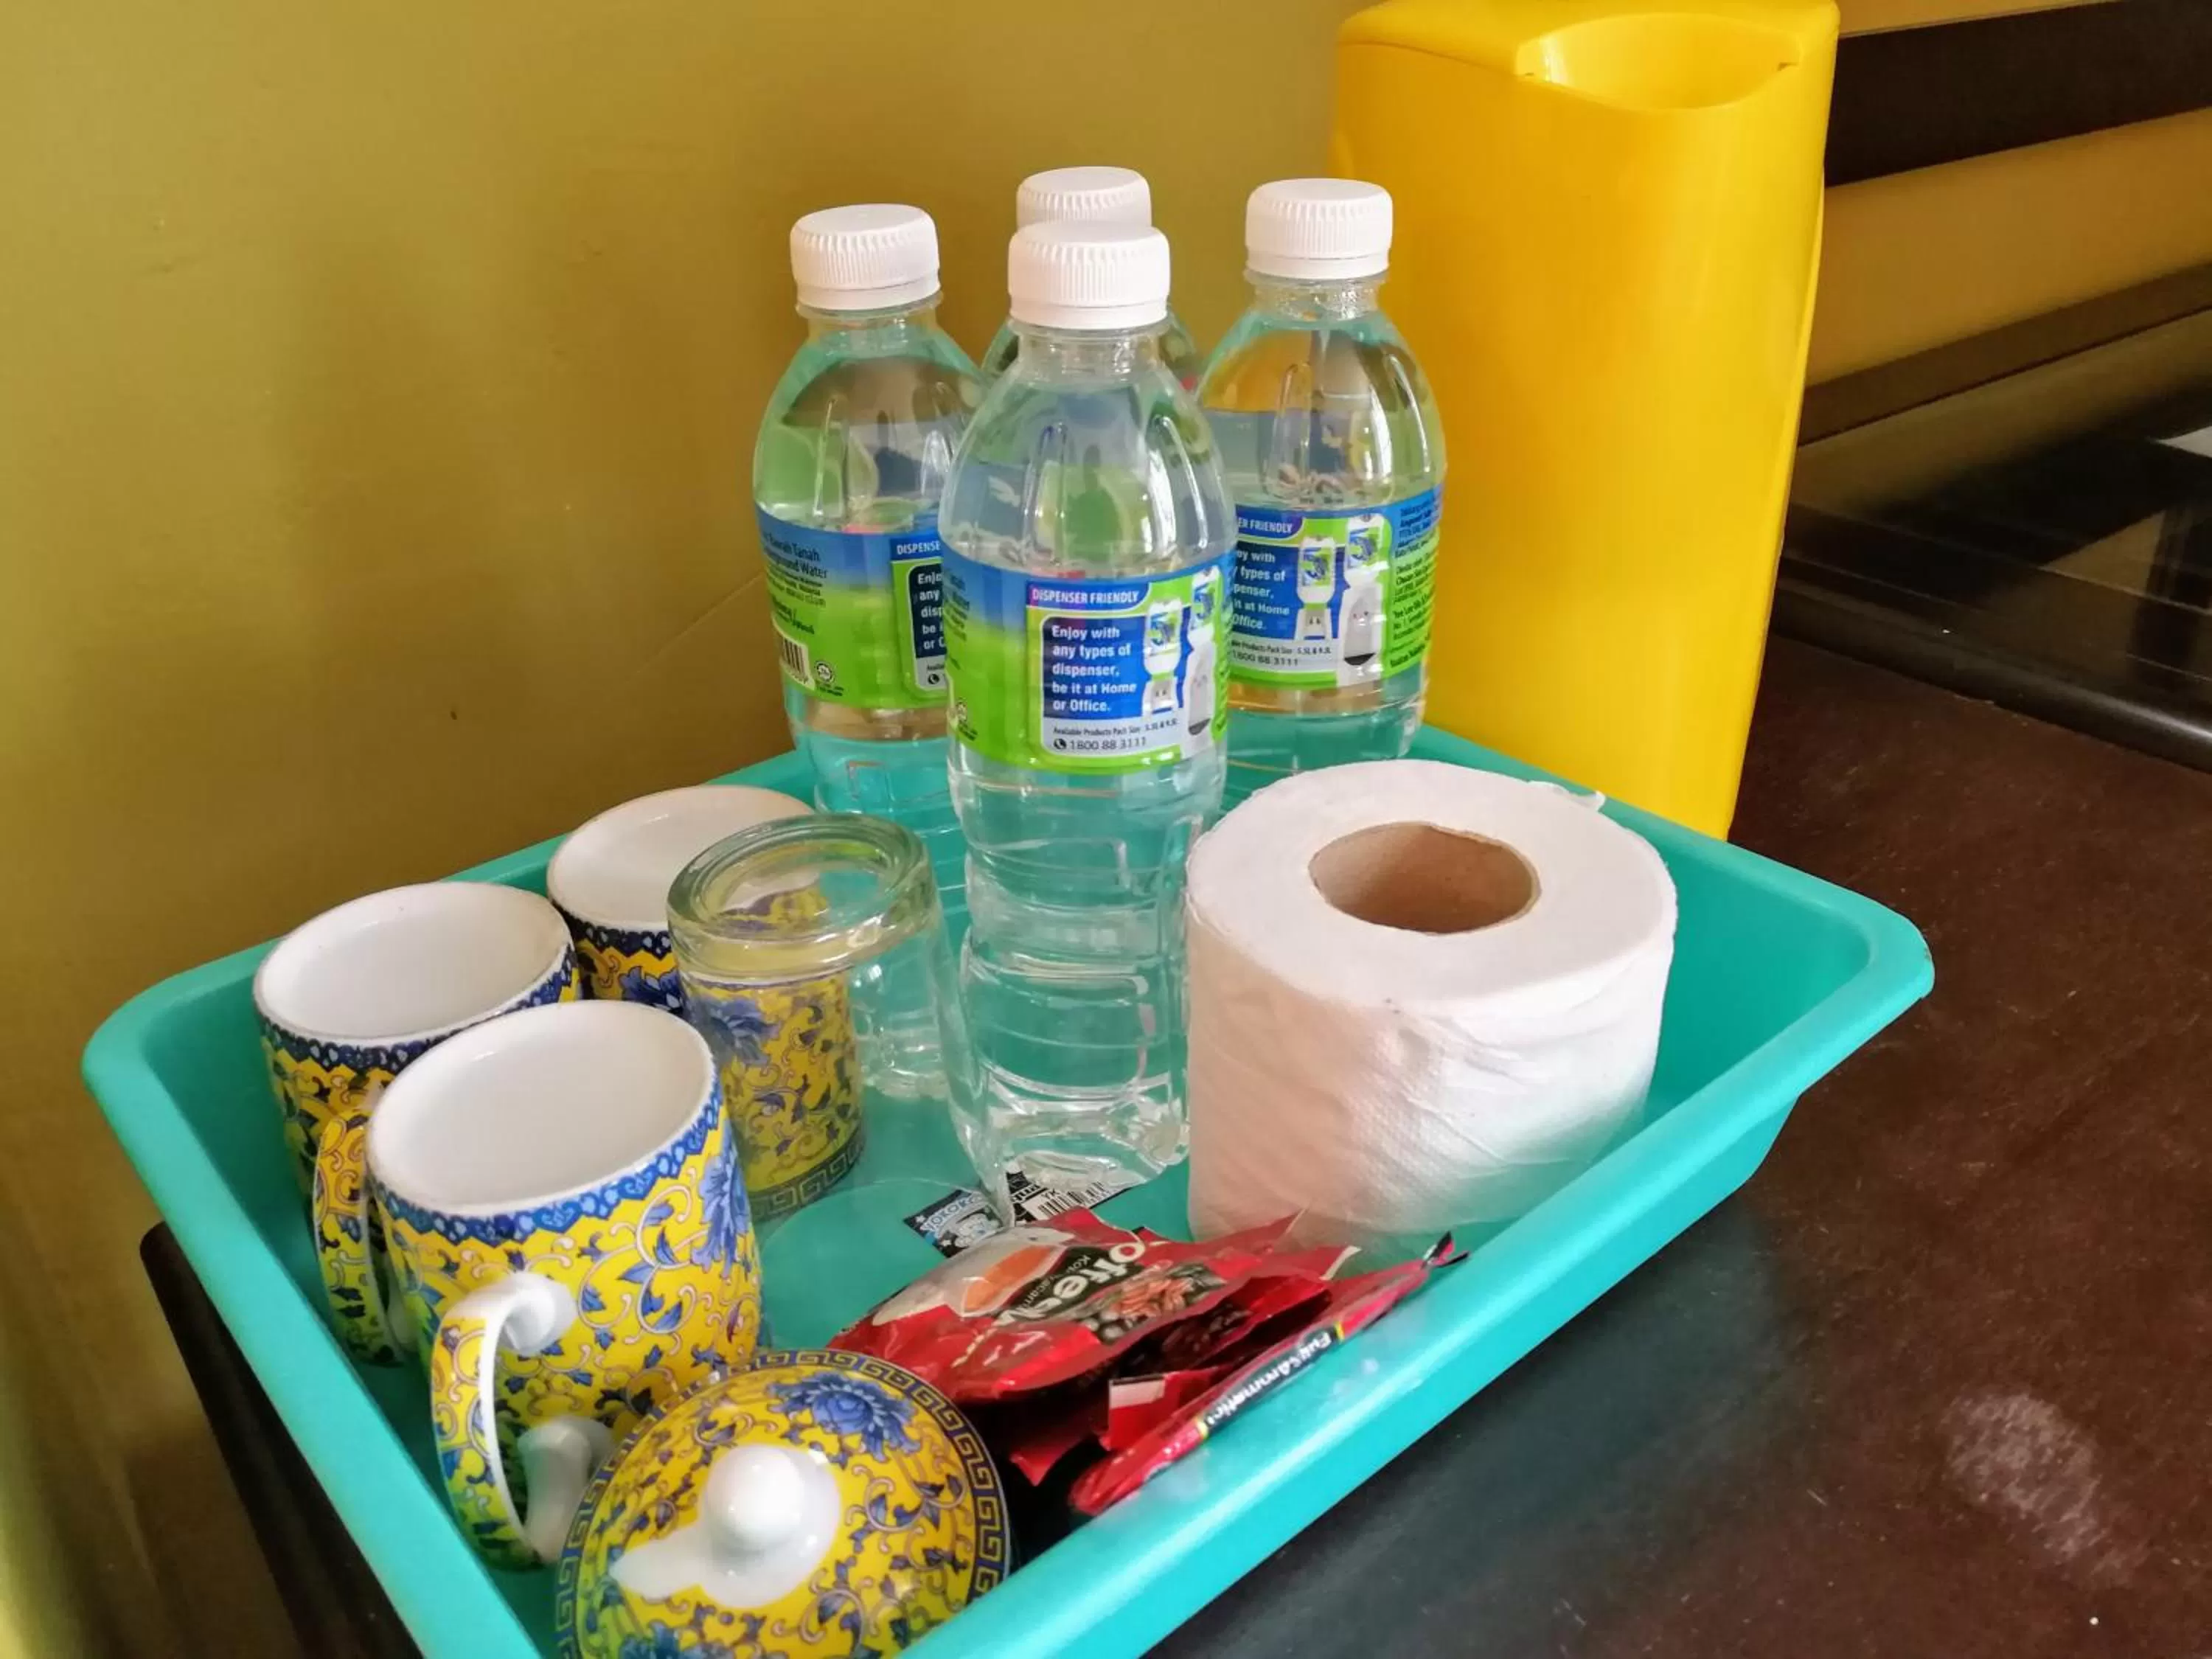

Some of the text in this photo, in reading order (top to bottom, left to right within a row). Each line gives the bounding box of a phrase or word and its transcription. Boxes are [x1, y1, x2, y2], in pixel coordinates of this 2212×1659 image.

[1250, 519, 1293, 533] FRIENDLY
[1251, 552, 1276, 563] with
[1241, 566, 1286, 582] types of
[919, 591, 940, 602] any
[1032, 588, 1140, 604] DISPENSER FRIENDLY
[1245, 601, 1256, 611] at
[1258, 604, 1290, 616] Home
[922, 624, 936, 634] be
[1051, 625, 1120, 641] Enjoy with
[923, 639, 935, 650] or
[1052, 643, 1132, 660] any types of
[1052, 681, 1138, 694] be it at Home
[1053, 698, 1111, 712] or Office.
[1070, 737, 1147, 751] 1800 88 3111
